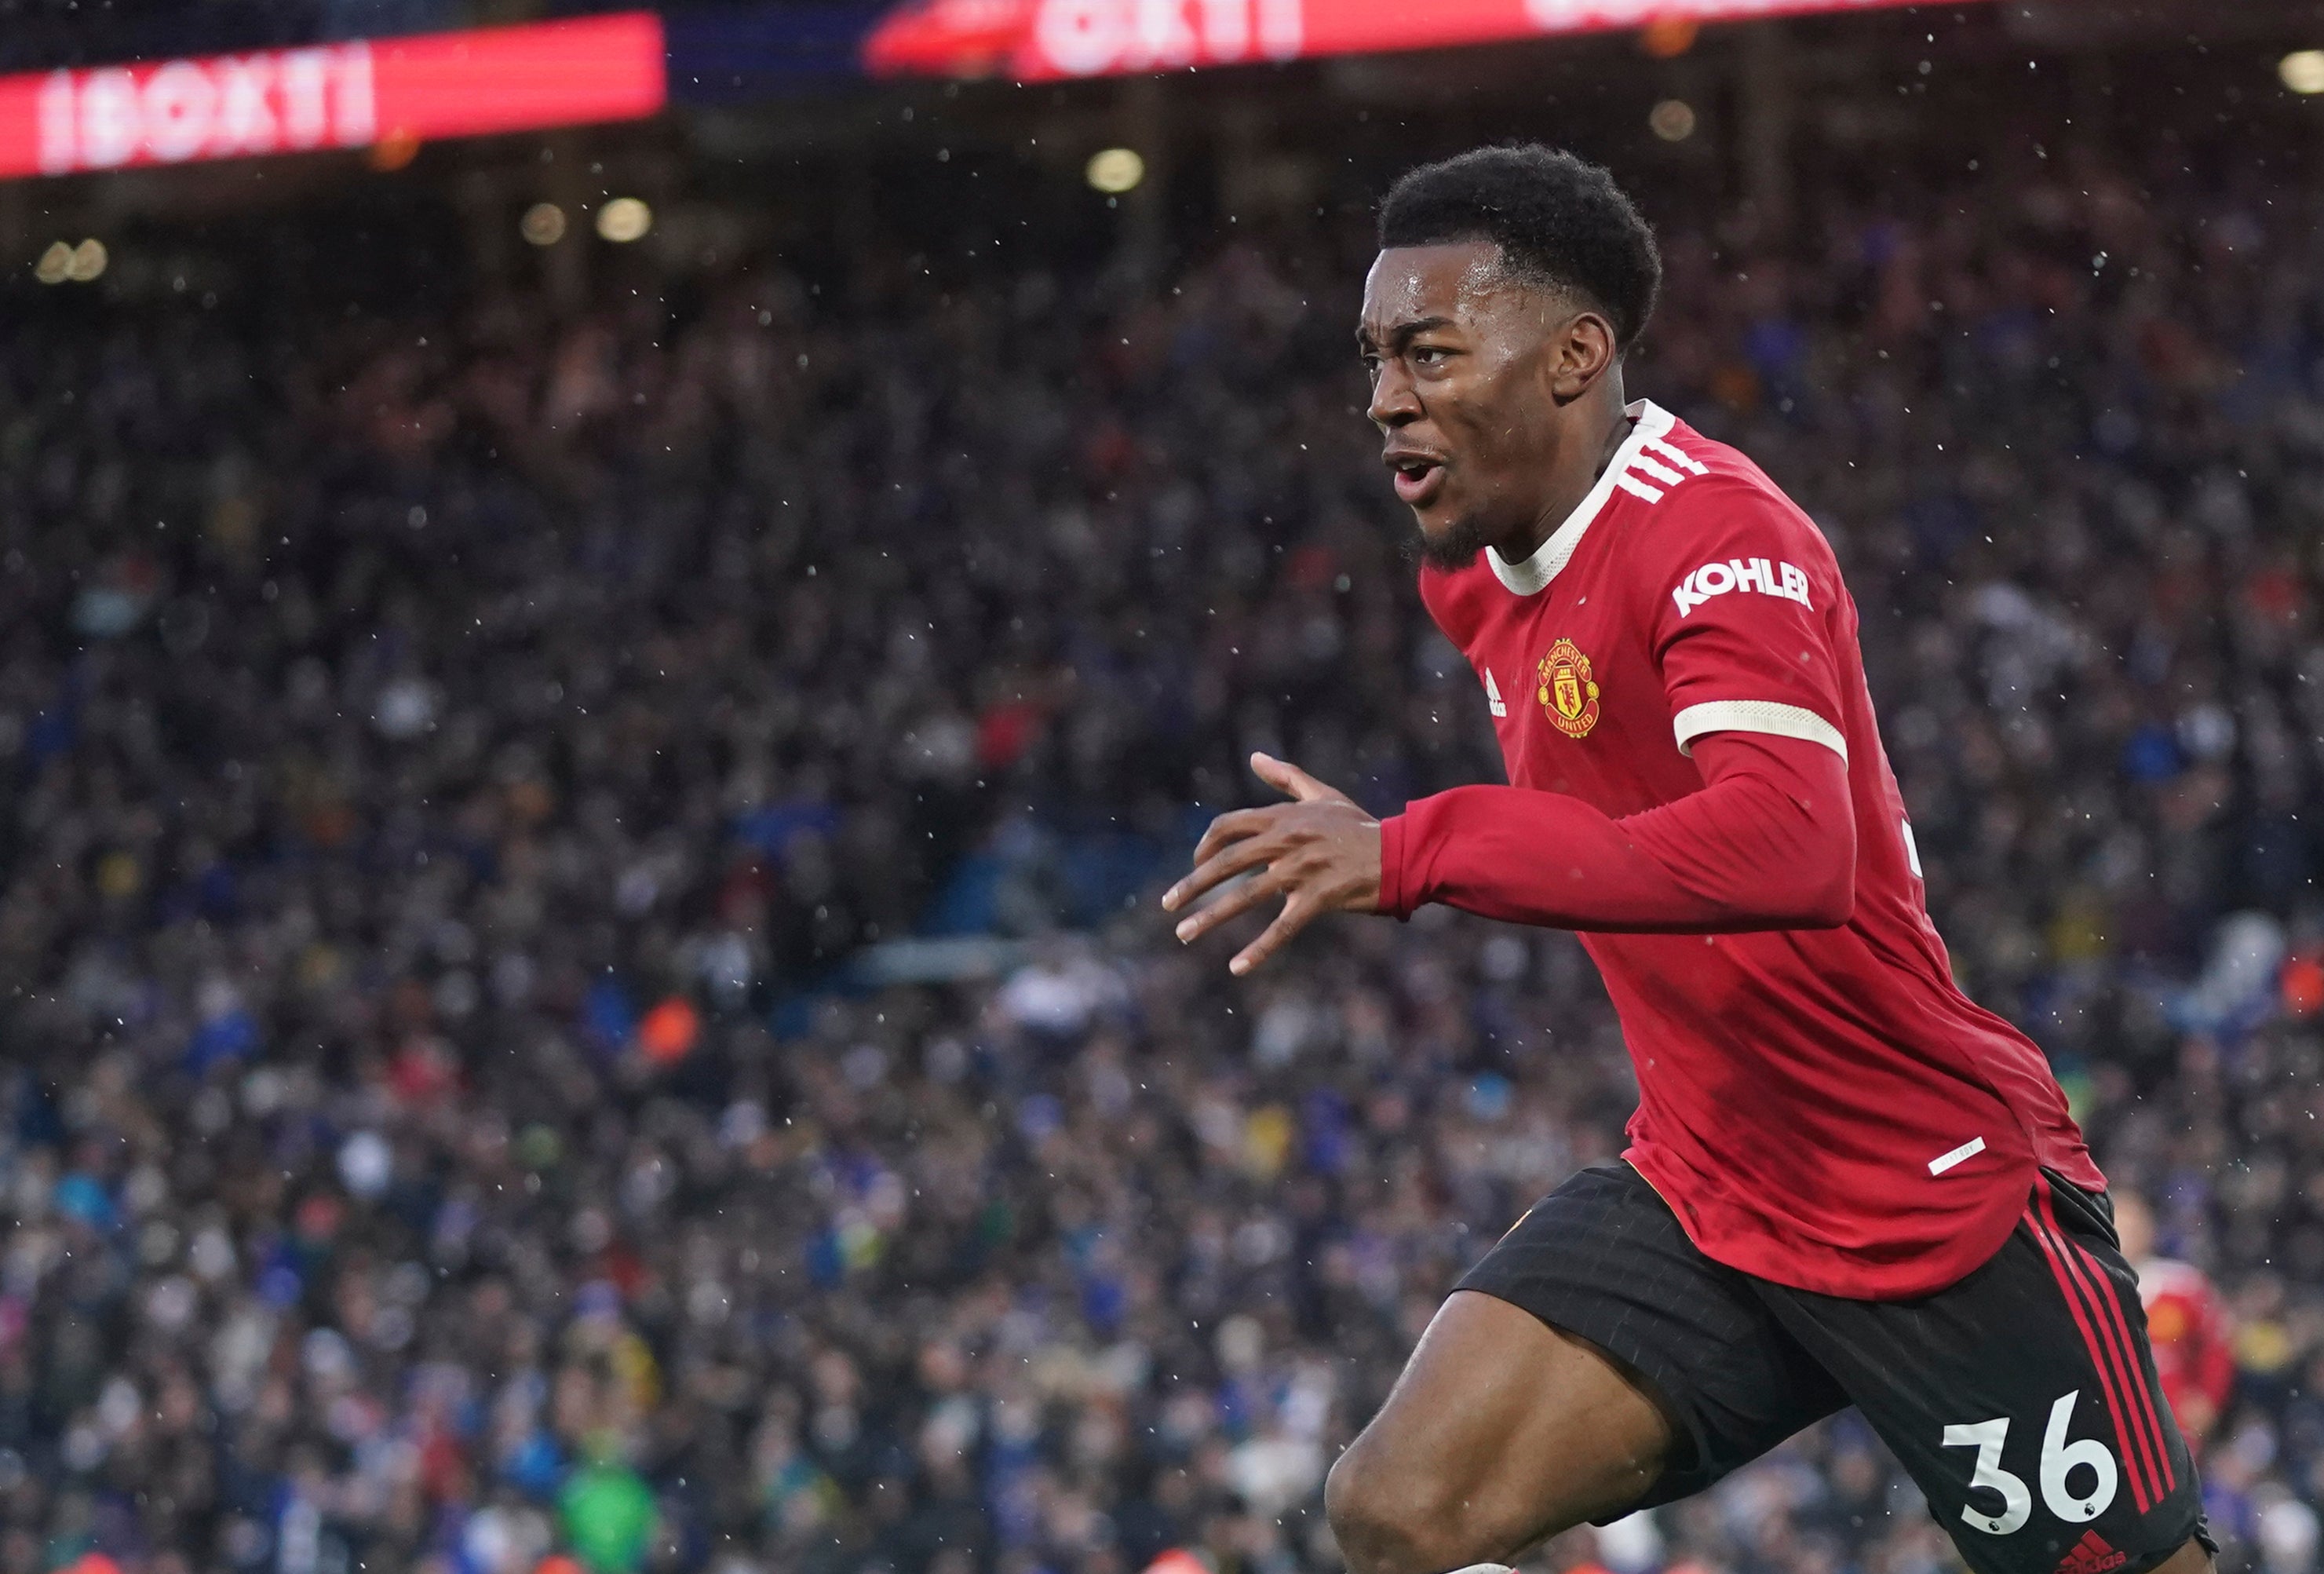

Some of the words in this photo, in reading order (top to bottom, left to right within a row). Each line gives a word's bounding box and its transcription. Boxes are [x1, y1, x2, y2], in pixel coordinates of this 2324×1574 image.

[1672, 557, 1815, 619] KOHLER
[1542, 645, 1588, 680] MANCHESTER
[1557, 713, 1593, 732] UNITED
[1941, 1389, 2118, 1536] 36
